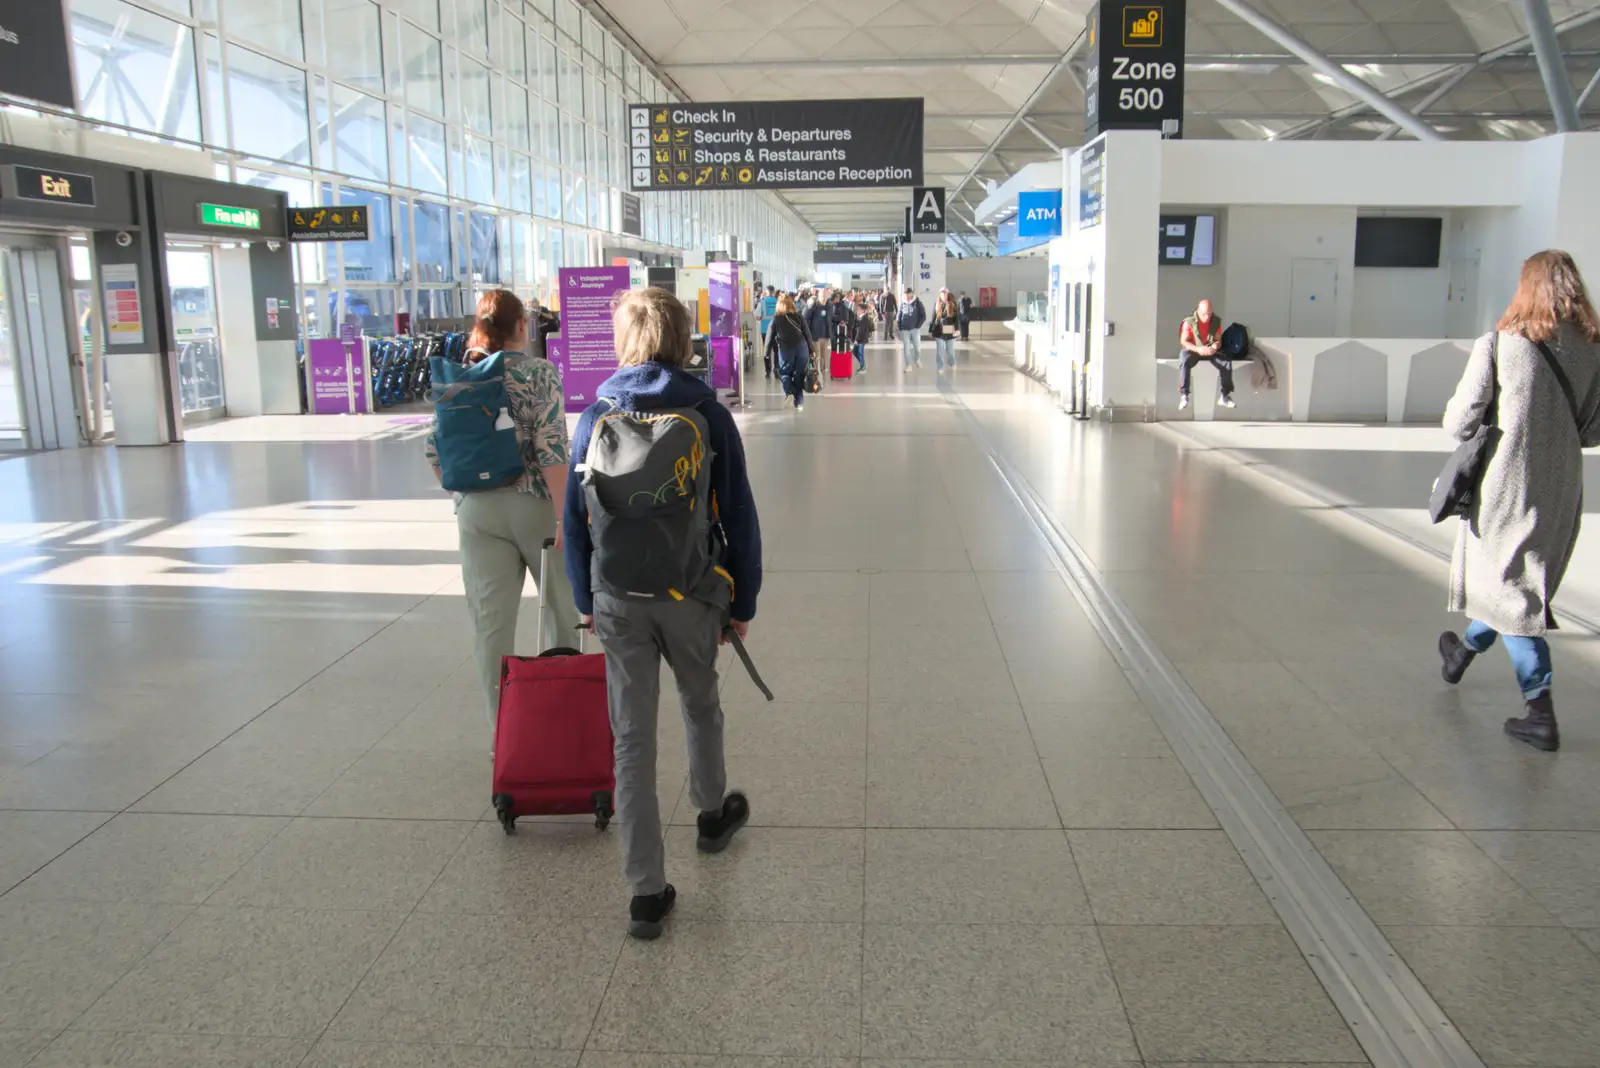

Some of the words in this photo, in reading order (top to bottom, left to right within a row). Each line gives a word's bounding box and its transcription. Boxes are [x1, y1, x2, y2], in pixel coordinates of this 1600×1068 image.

[1112, 57, 1176, 80] Zone
[1119, 87, 1164, 110] 500
[672, 109, 719, 124] Check
[722, 109, 736, 123] In
[694, 128, 753, 145] Security
[757, 128, 768, 143] &
[771, 127, 852, 144] Departures
[694, 149, 741, 165] Shops
[744, 148, 755, 162] &
[759, 148, 846, 162] Restaurants
[757, 168, 835, 182] Assistance
[839, 166, 912, 182] Reception
[40, 174, 72, 198] Exit
[916, 190, 942, 218] A
[1026, 208, 1056, 221] ATM
[329, 230, 365, 239] Reception
[920, 223, 937, 231] 1-16
[920, 252, 925, 260] 1
[920, 261, 930, 269] to
[920, 272, 930, 280] 16
